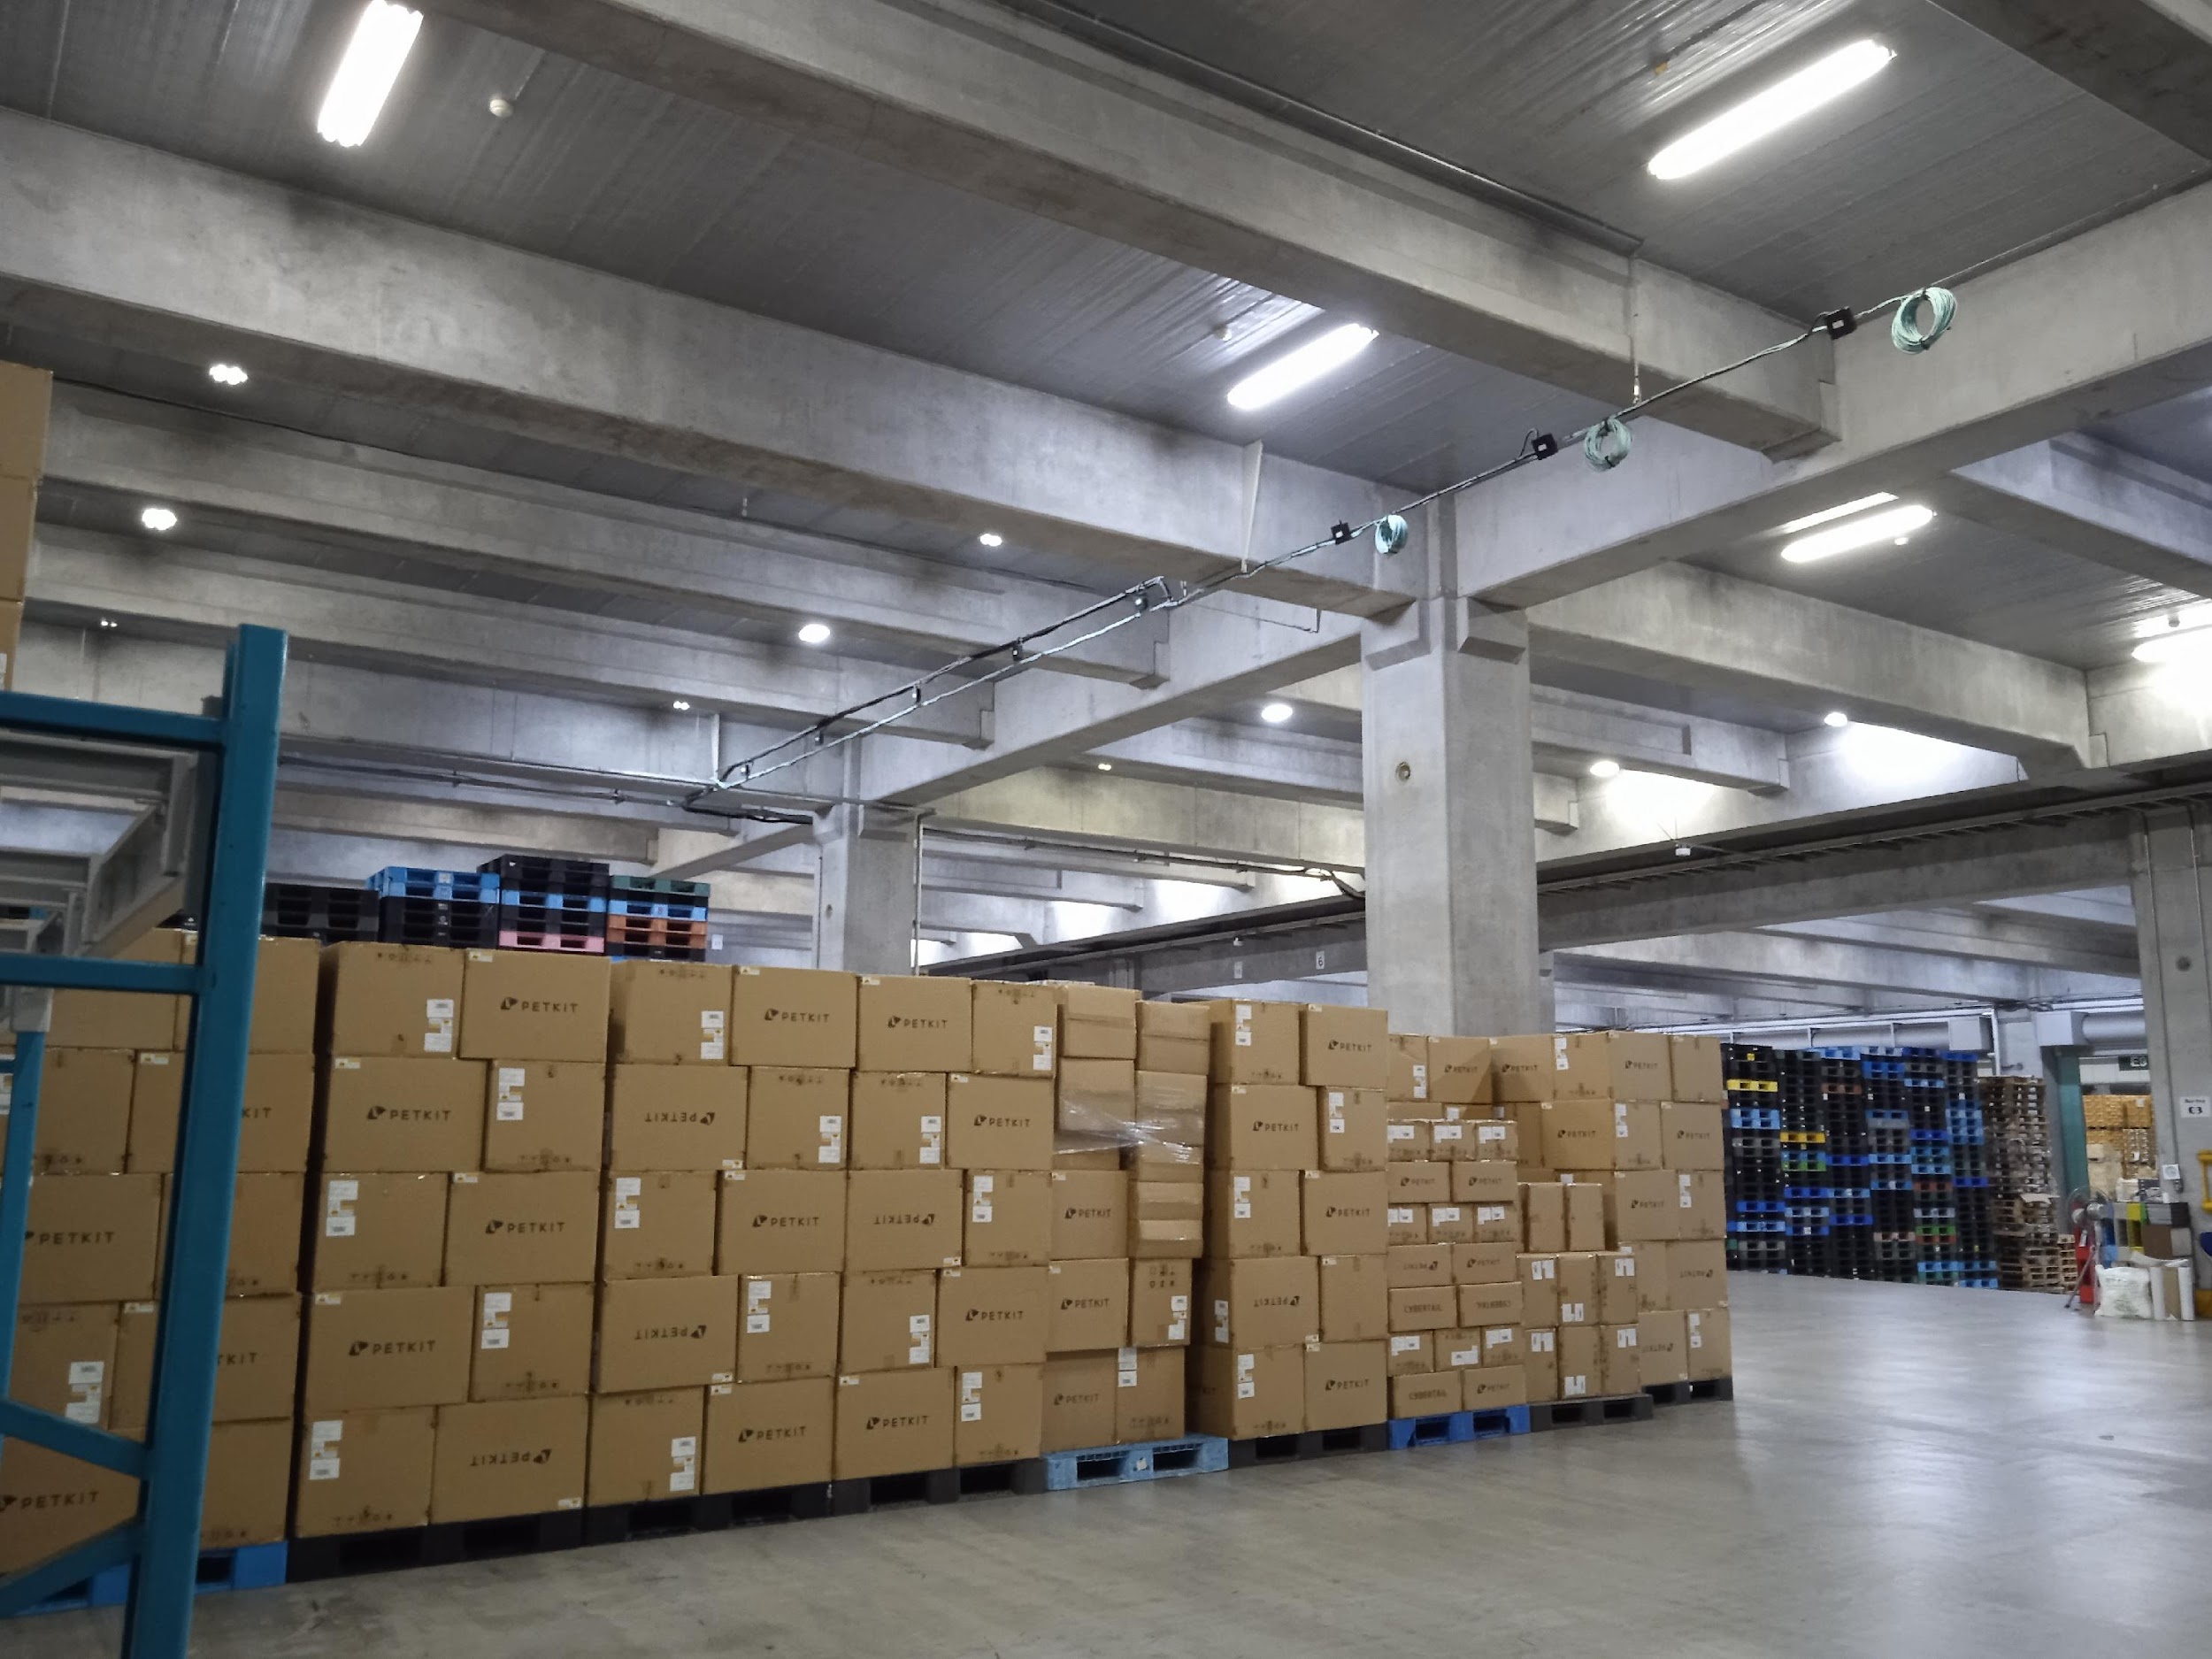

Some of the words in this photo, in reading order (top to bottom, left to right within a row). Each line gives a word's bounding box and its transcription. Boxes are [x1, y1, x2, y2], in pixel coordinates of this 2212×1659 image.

[521, 1002, 578, 1013] PETKIT
[782, 1012, 829, 1023] PETKIT
[904, 1018, 948, 1029] PETKIT
[1340, 1042, 1371, 1052] PETKIT
[242, 1107, 272, 1119] KIT
[390, 1109, 450, 1122] PETKIT
[645, 1112, 697, 1124] PETKIT
[989, 1118, 1031, 1127] PETKIT
[1264, 1123, 1299, 1132] PETKIT
[1078, 1209, 1111, 1217] PETKIT
[1338, 1208, 1370, 1217] PETKIT
[771, 1217, 819, 1227] PETKIT
[874, 1214, 920, 1225] PETKIT
[507, 1222, 565, 1233] PETKIT
[39, 1232, 114, 1245] PETKIT
[1076, 1298, 1110, 1309] PETKIT
[1254, 1297, 1289, 1307] PETKIT
[981, 1310, 1024, 1320] PETKIT
[634, 1328, 687, 1340] PETKIT
[372, 1340, 435, 1356] PETKIT
[218, 1352, 257, 1365] TKIT
[1337, 1379, 1369, 1389] PETKIT
[1066, 1394, 1099, 1403] PETKIT
[882, 1416, 928, 1427] PETKIT
[757, 1426, 806, 1440] PETKIT
[471, 1451, 531, 1467] PETKIT
[21, 1491, 99, 1509] PETKIT
